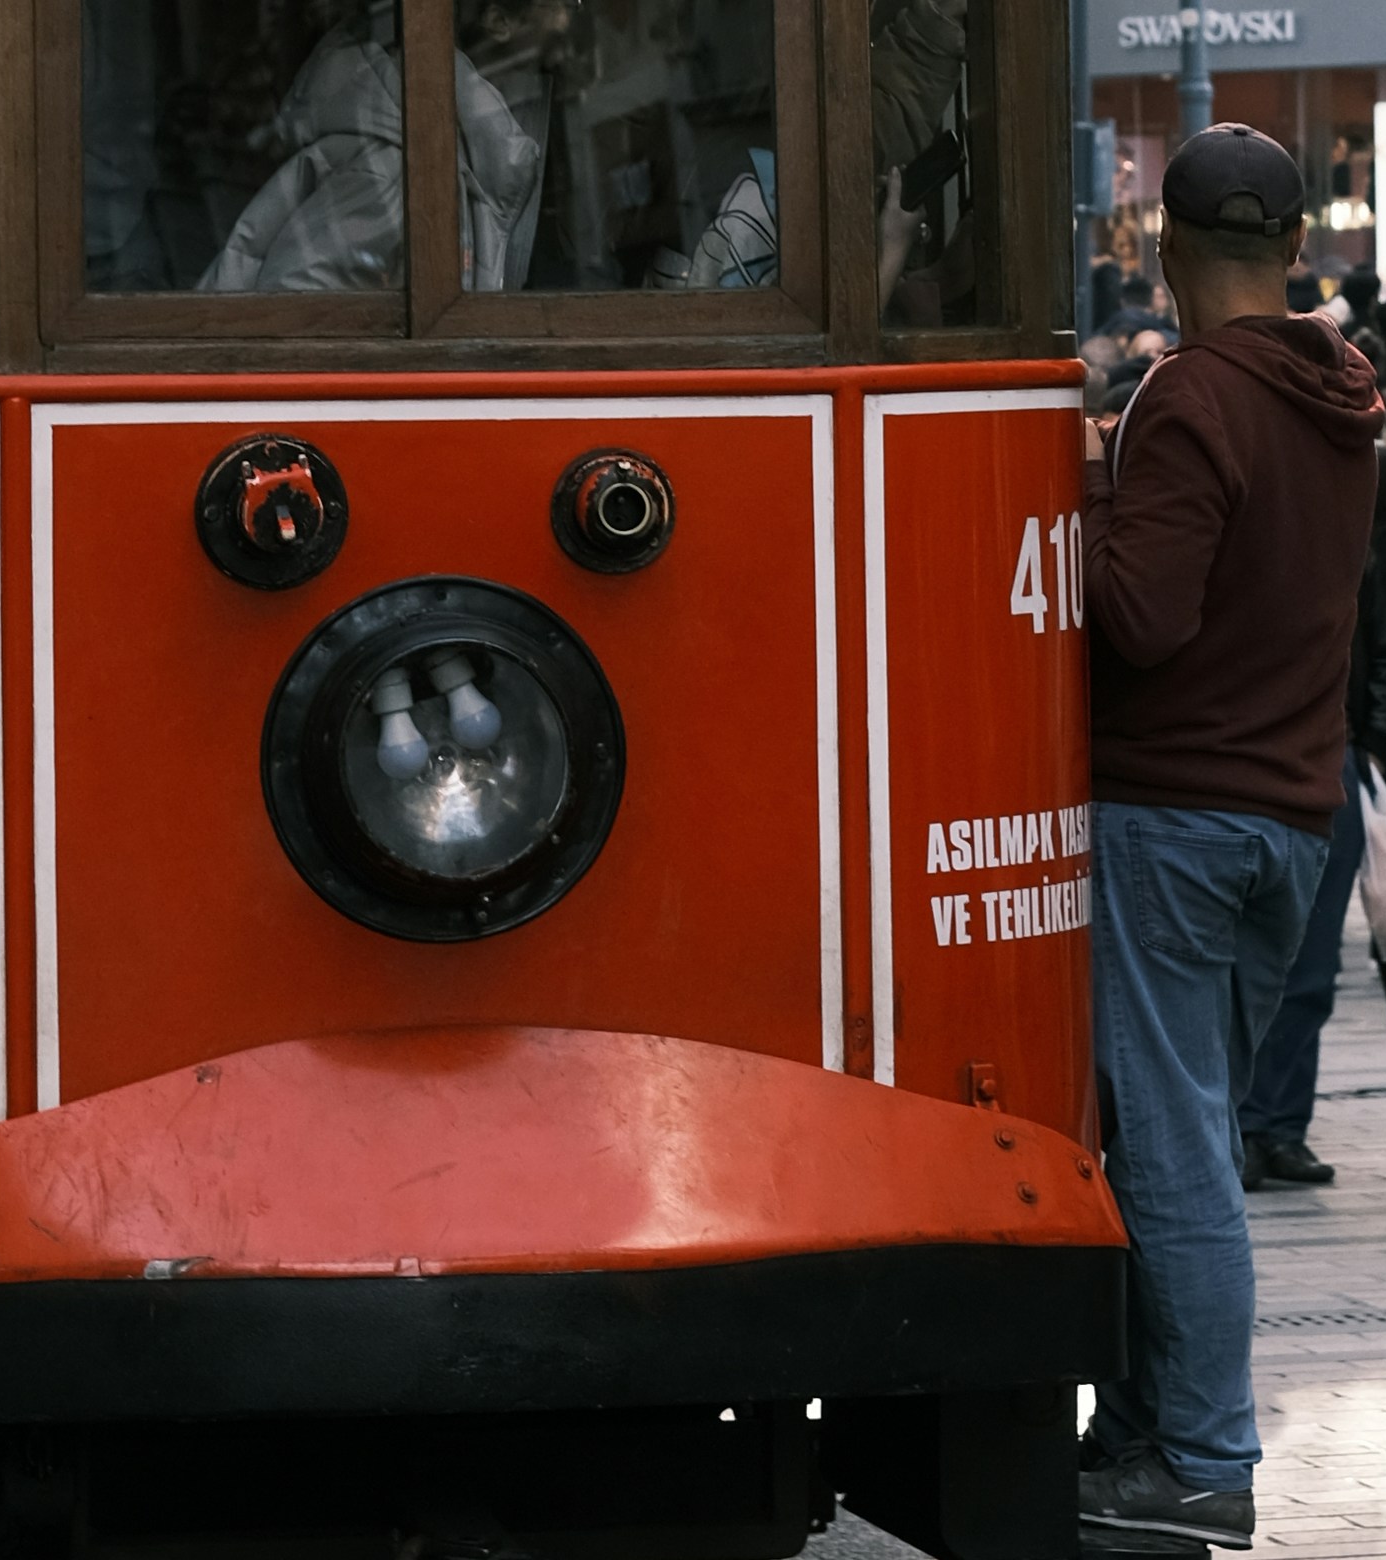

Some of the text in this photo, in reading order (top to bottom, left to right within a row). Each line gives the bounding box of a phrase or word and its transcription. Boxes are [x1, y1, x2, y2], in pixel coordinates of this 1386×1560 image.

[1118, 8, 1296, 49] SWAOVSKI
[1010, 511, 1084, 634] 410
[927, 811, 1055, 874] ASILMAK
[931, 893, 972, 946] VE
